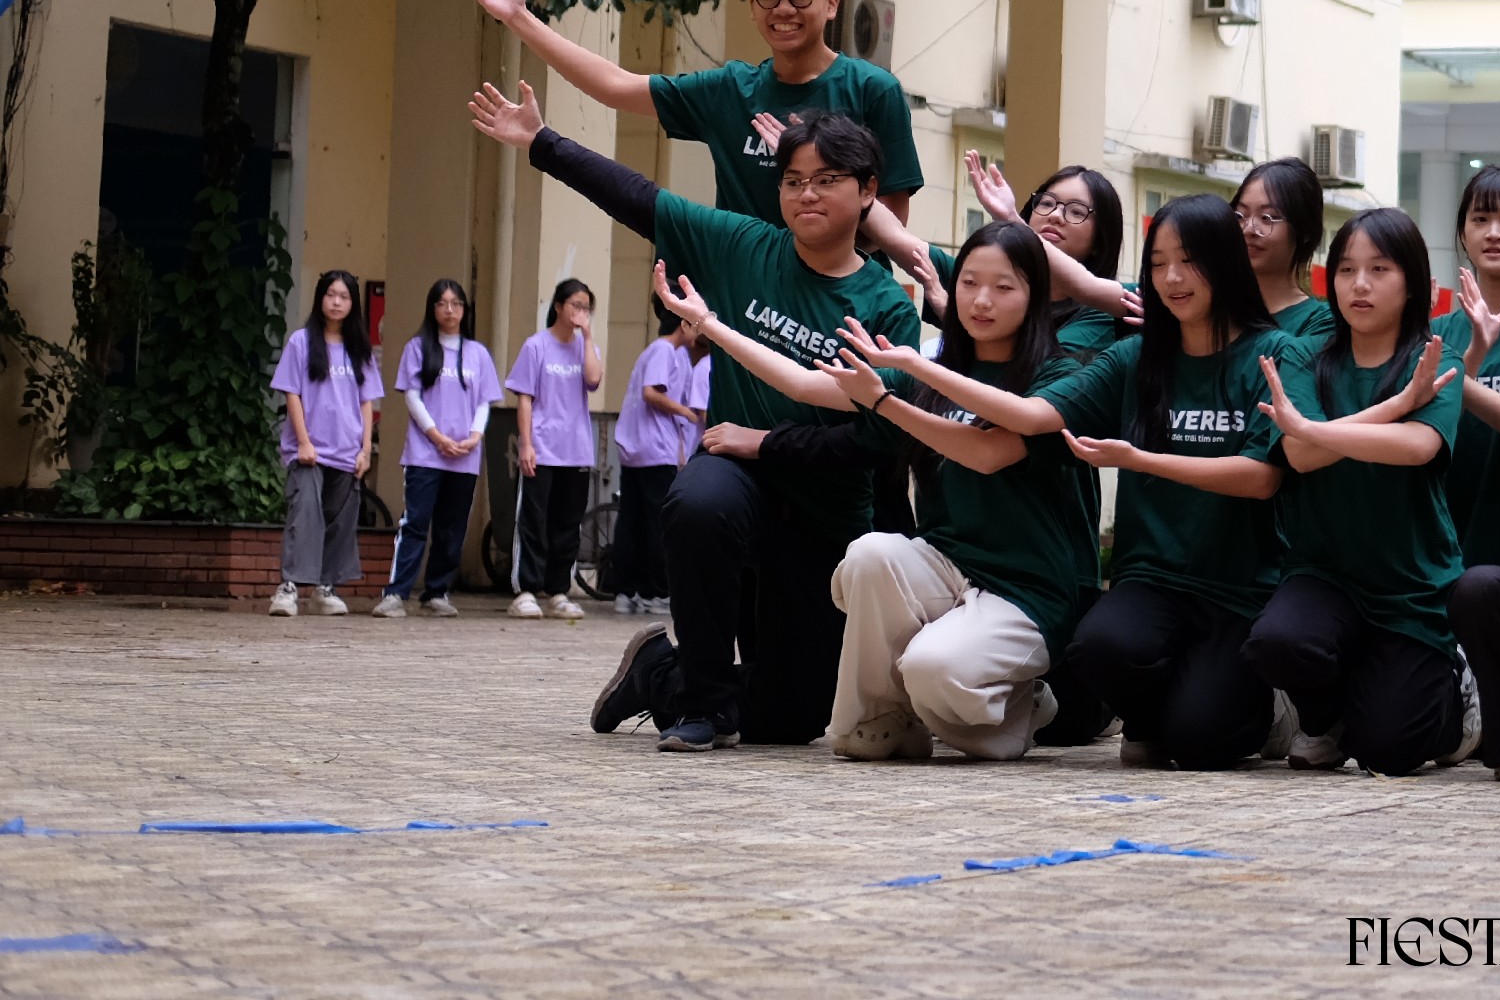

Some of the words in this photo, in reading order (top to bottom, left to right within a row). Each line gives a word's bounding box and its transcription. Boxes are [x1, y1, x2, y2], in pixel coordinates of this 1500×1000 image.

[744, 298, 839, 358] LAVERES
[545, 363, 582, 375] SOLON
[1168, 409, 1245, 432] VERES
